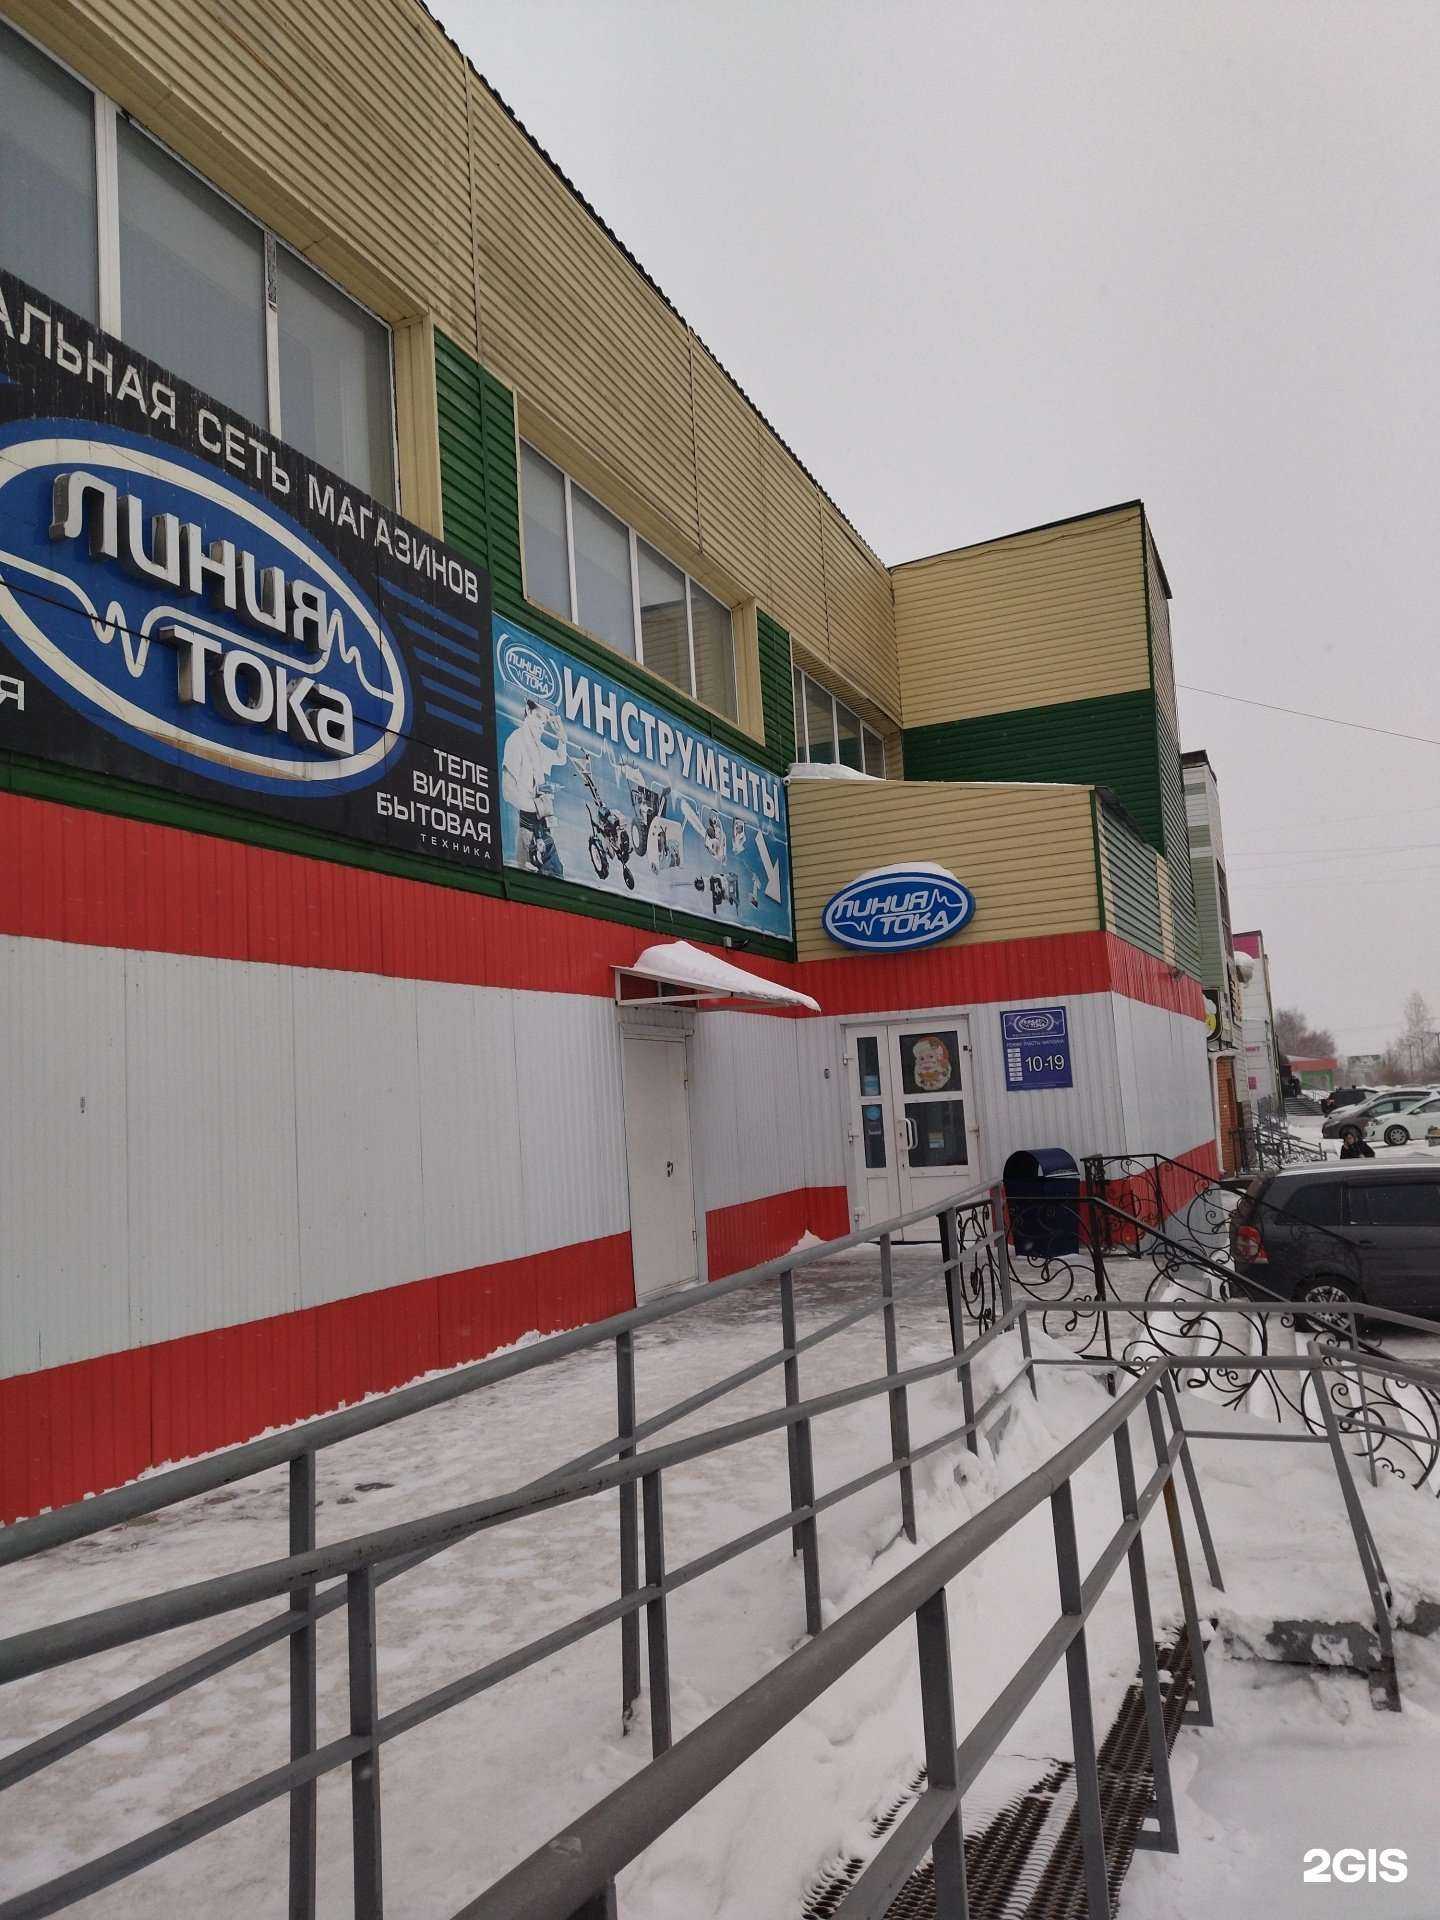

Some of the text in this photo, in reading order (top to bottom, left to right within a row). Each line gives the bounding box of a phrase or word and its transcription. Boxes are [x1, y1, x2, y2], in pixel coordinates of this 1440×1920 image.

[198, 408, 291, 496] СЕТЬ
[307, 473, 479, 604] МАГАЗИНОВ
[563, 665, 781, 823] ИНСТРУМЕНТЫ
[433, 748, 489, 788] ТЕЛЕ
[413, 770, 490, 814] ВИДЕО
[376, 791, 491, 844] БЫТОВАЯ
[420, 833, 491, 860] ТЕХНИКА
[880, 910, 950, 936] ТОКА
[1025, 1054, 1065, 1072] 10-19
